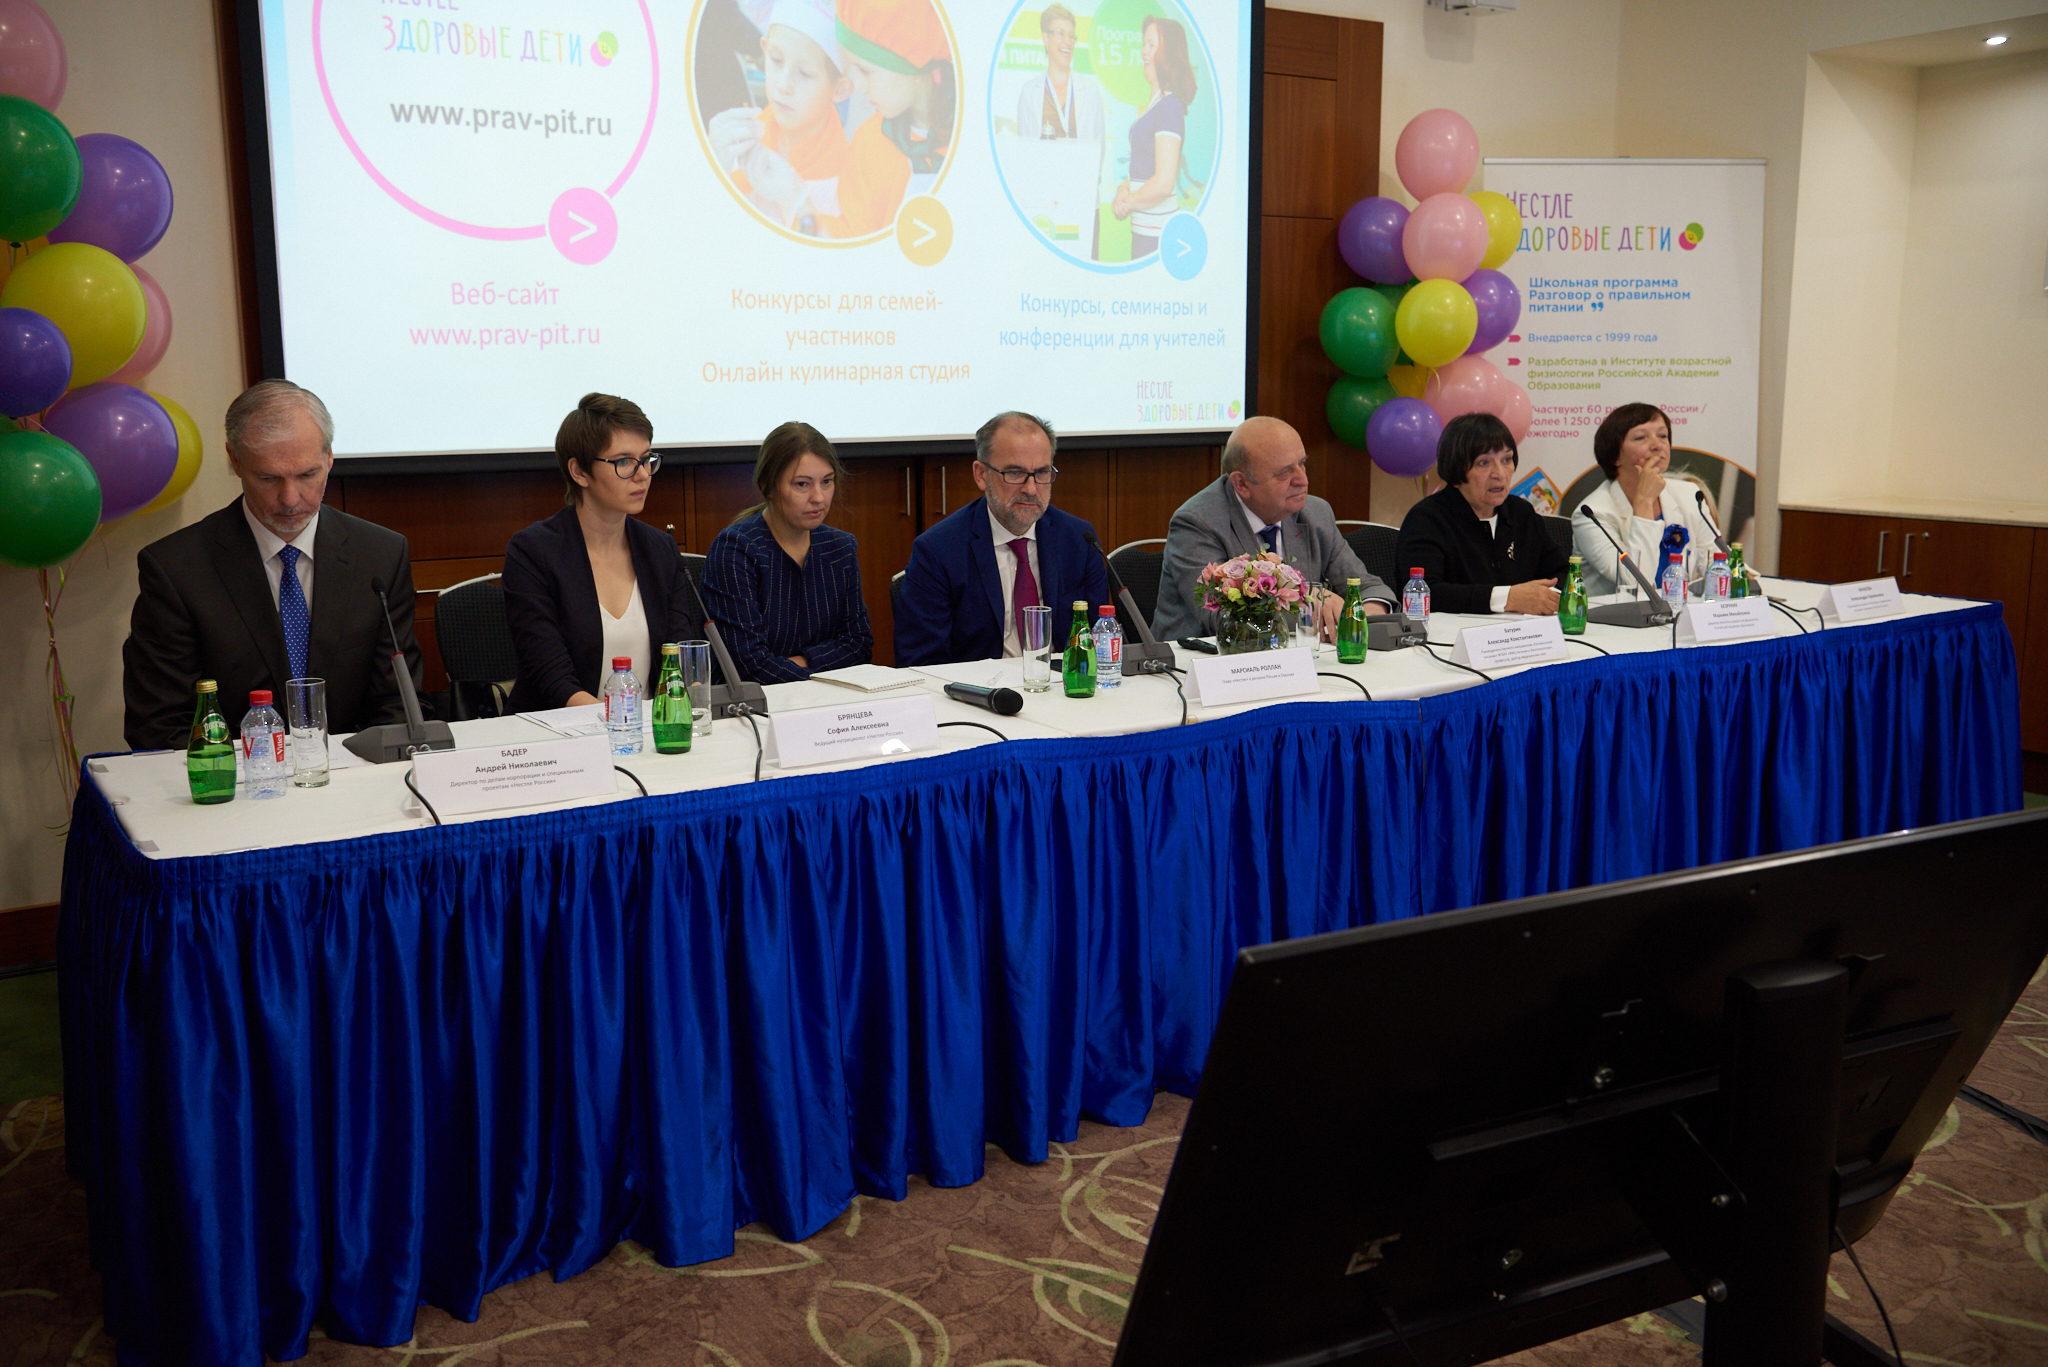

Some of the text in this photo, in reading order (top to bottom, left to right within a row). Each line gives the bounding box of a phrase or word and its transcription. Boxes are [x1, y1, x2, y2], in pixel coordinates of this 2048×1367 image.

[382, 16, 582, 67] ЗДОРОВЫЕ ДЕТИ
[390, 103, 612, 139] www.prav-pit.ru
[1516, 226, 1671, 252] ДОРОВЫЕ ДЕТИ
[1529, 278, 1679, 291] Школьная программа
[451, 282, 560, 306] Веб-сайт
[731, 288, 943, 314] Конкурсы для семей-
[1529, 290, 1691, 302] Разговор о правильном
[1020, 293, 1208, 319] Конкурсы, семинары и
[1529, 303, 1584, 313] питании
[410, 323, 600, 350] www.prav-pit.ru
[785, 328, 896, 350] участников
[1000, 328, 1226, 350] конференции для учителей
[1528, 333, 1592, 344] Внедряется
[1605, 333, 1631, 342] 1999
[1634, 335, 1658, 344] года
[1528, 357, 1598, 369] Разработана
[1611, 357, 1666, 368] Институте
[1670, 356, 1732, 367] возрастной
[702, 361, 971, 385] Онлайн кулинарная студия
[1527, 368, 1720, 380] физиологии Российской Академии
[1137, 380, 1173, 399] НЕСТЛЕ
[1527, 381, 1601, 392] Образования
[1138, 403, 1224, 422] ЗДОРОВЫЕ ДЕТИ
[1587, 405, 1602, 414] 60
[1660, 405, 1699, 414] России
[1571, 417, 1591, 426] 250
[1526, 429, 1580, 439] ежегодно
[837, 711, 873, 721] БРЯНЦЕВА
[827, 721, 889, 735] София Алексеевна
[501, 748, 528, 758] БАДЕР
[475, 759, 557, 774] Андрей Николаевич
[450, 779, 478, 788] Директор
[487, 776, 506, 784] делам
[506, 772, 541, 782] корпорации
